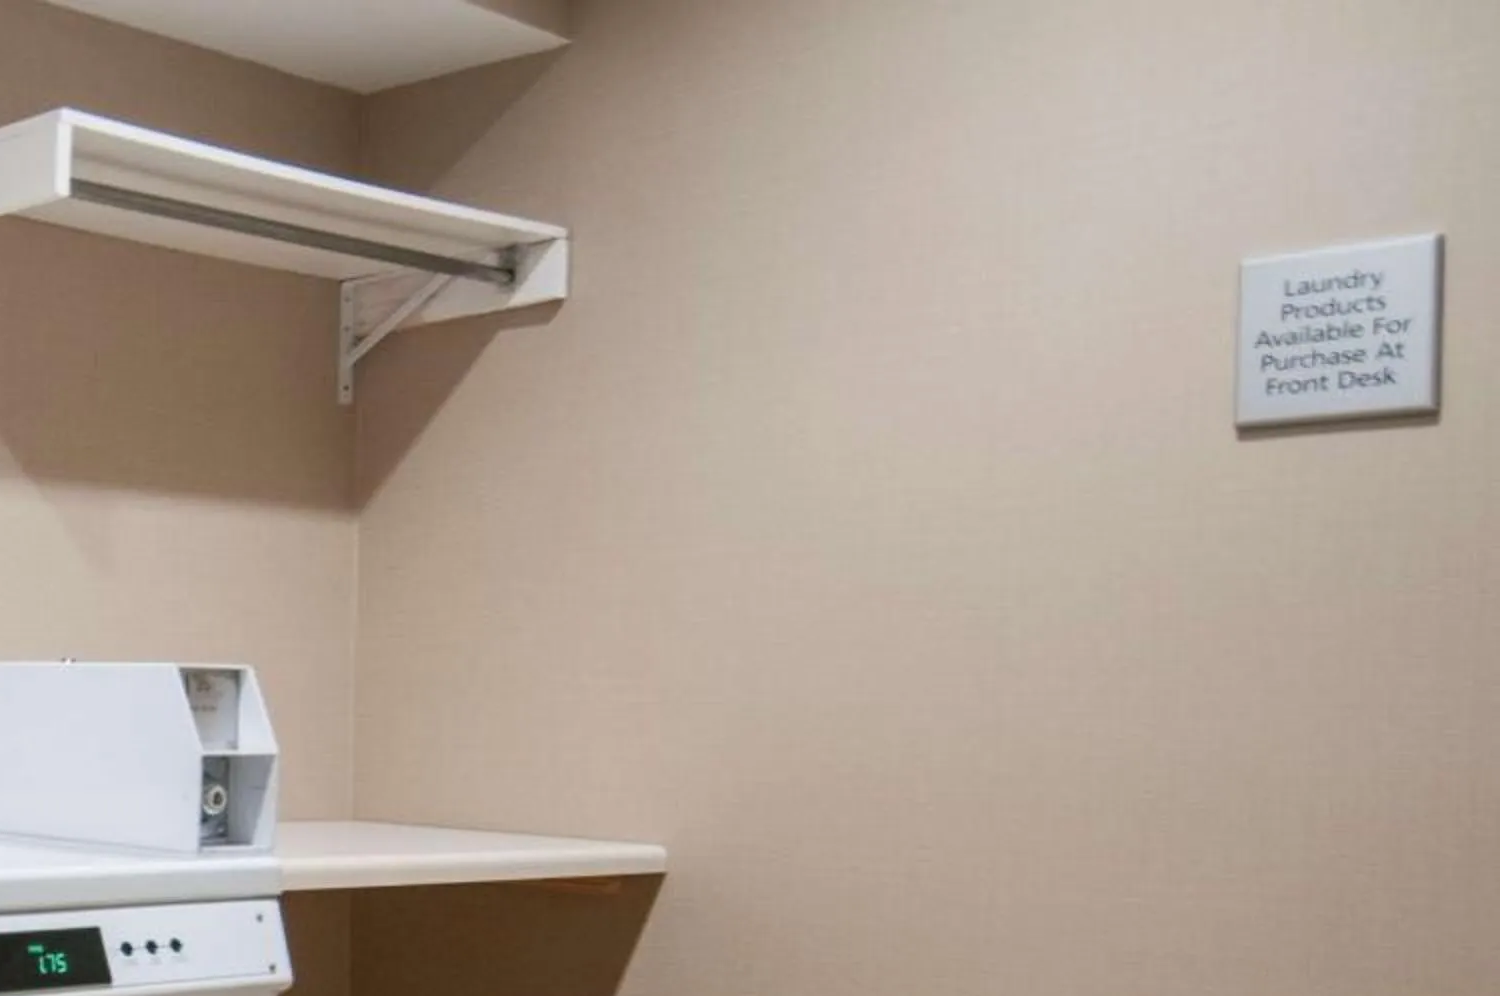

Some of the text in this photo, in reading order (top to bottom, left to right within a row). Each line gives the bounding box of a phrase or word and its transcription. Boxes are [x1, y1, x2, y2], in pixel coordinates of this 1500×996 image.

[1284, 268, 1384, 297] Laundry
[1281, 295, 1387, 322] Products
[1254, 317, 1412, 349] Available For
[1260, 341, 1405, 372] Purchase At
[1265, 368, 1397, 396] Front Desk
